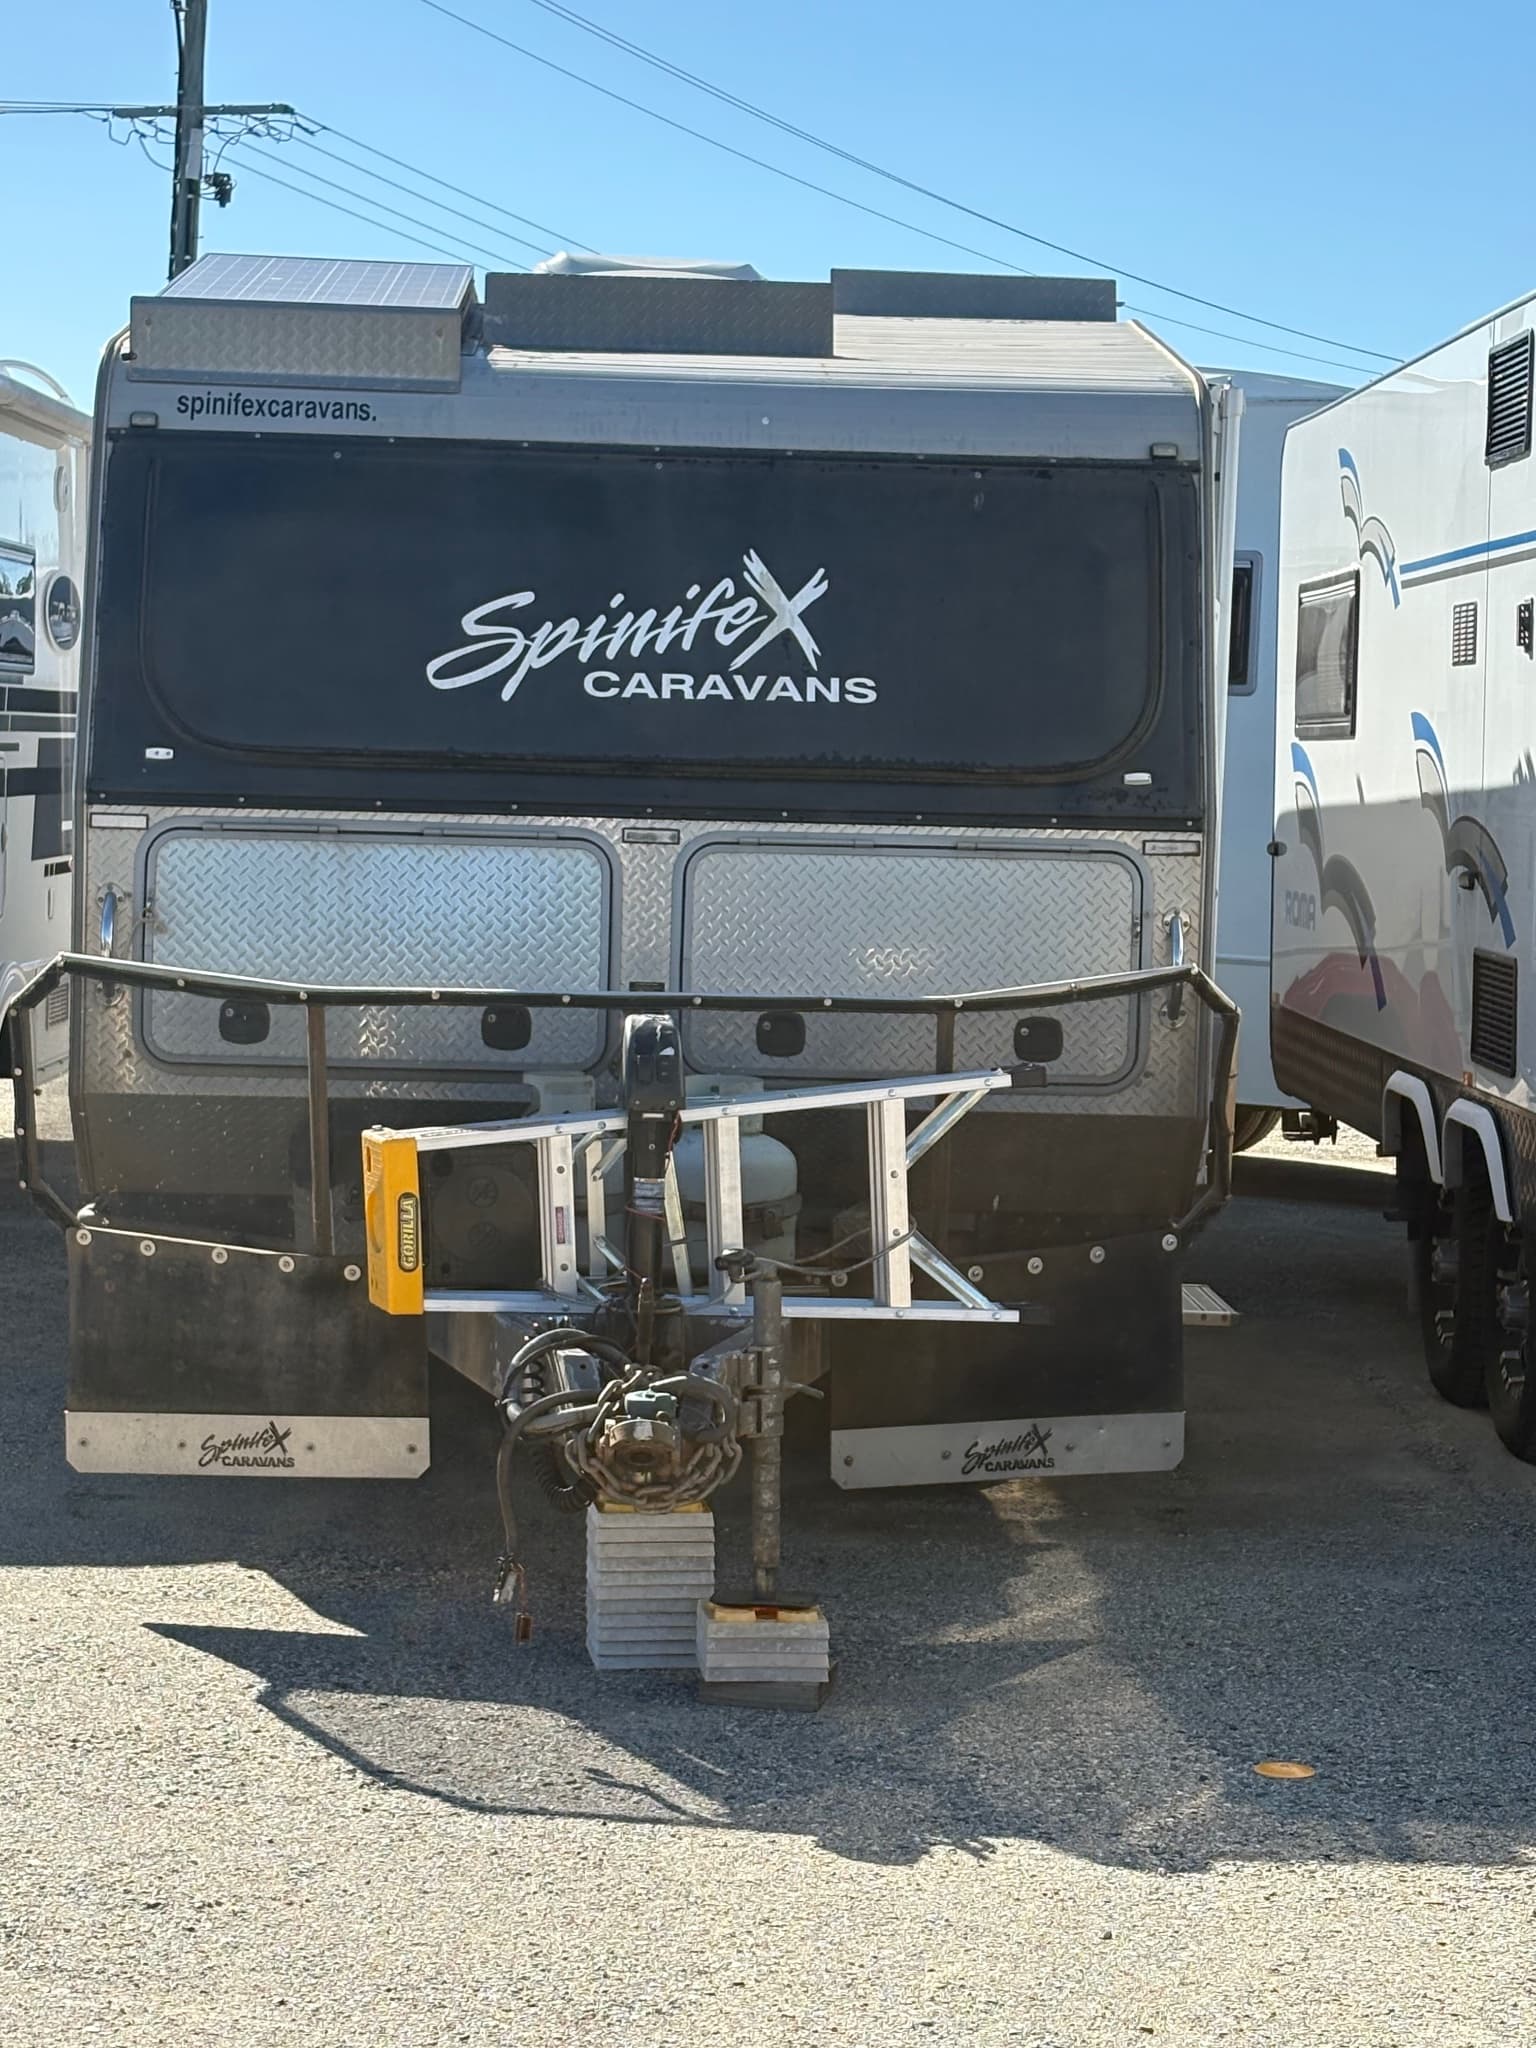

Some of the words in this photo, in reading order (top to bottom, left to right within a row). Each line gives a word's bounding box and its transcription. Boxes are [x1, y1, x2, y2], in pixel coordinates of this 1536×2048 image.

[177, 390, 377, 422] spinifexcaravans.
[583, 671, 878, 704] CARAVANS
[401, 1198, 416, 1268] GORILLA
[222, 1455, 296, 1468] CARAVANS
[984, 1457, 1055, 1472] CARAVANS
